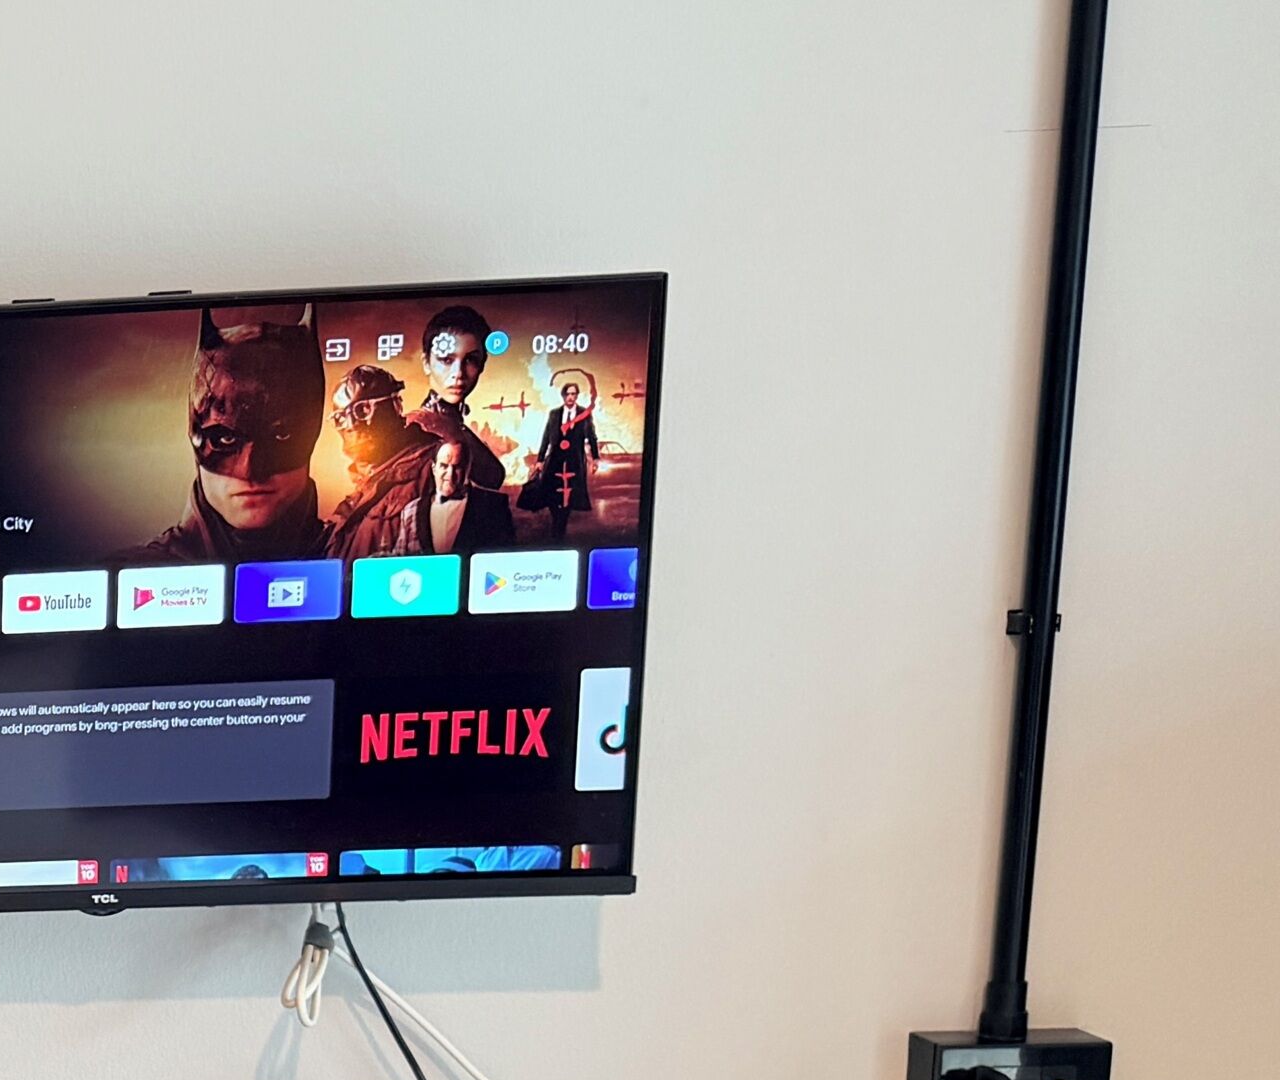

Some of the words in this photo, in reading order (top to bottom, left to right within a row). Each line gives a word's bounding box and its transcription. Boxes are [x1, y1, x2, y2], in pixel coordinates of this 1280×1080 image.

[532, 333, 589, 354] 08:40
[3, 516, 33, 533] City
[513, 572, 543, 582] Google
[545, 572, 562, 581] Play
[161, 587, 190, 597] Google
[192, 586, 208, 595] Play
[513, 584, 536, 592] Store
[44, 593, 91, 611] YouTube
[197, 597, 207, 605] TV
[19, 704, 37, 716] will
[38, 702, 109, 716] automatically
[111, 702, 149, 715] appear
[151, 700, 176, 710] here
[177, 700, 191, 709] so
[193, 699, 214, 711] you
[215, 698, 236, 708] can
[237, 696, 268, 708] easily
[269, 695, 311, 706] resume
[1, 723, 22, 734] add
[24, 722, 77, 736] programs
[78, 720, 93, 733] by
[95, 717, 169, 733] long-pressing
[171, 716, 189, 728] the
[190, 715, 224, 727] center
[226, 714, 262, 725] button
[264, 714, 278, 724] on
[279, 713, 306, 725] your
[360, 707, 552, 764] NETFLIX
[310, 861, 324, 873] 10
[81, 869, 96, 881] 10
[92, 894, 119, 903] TCL
